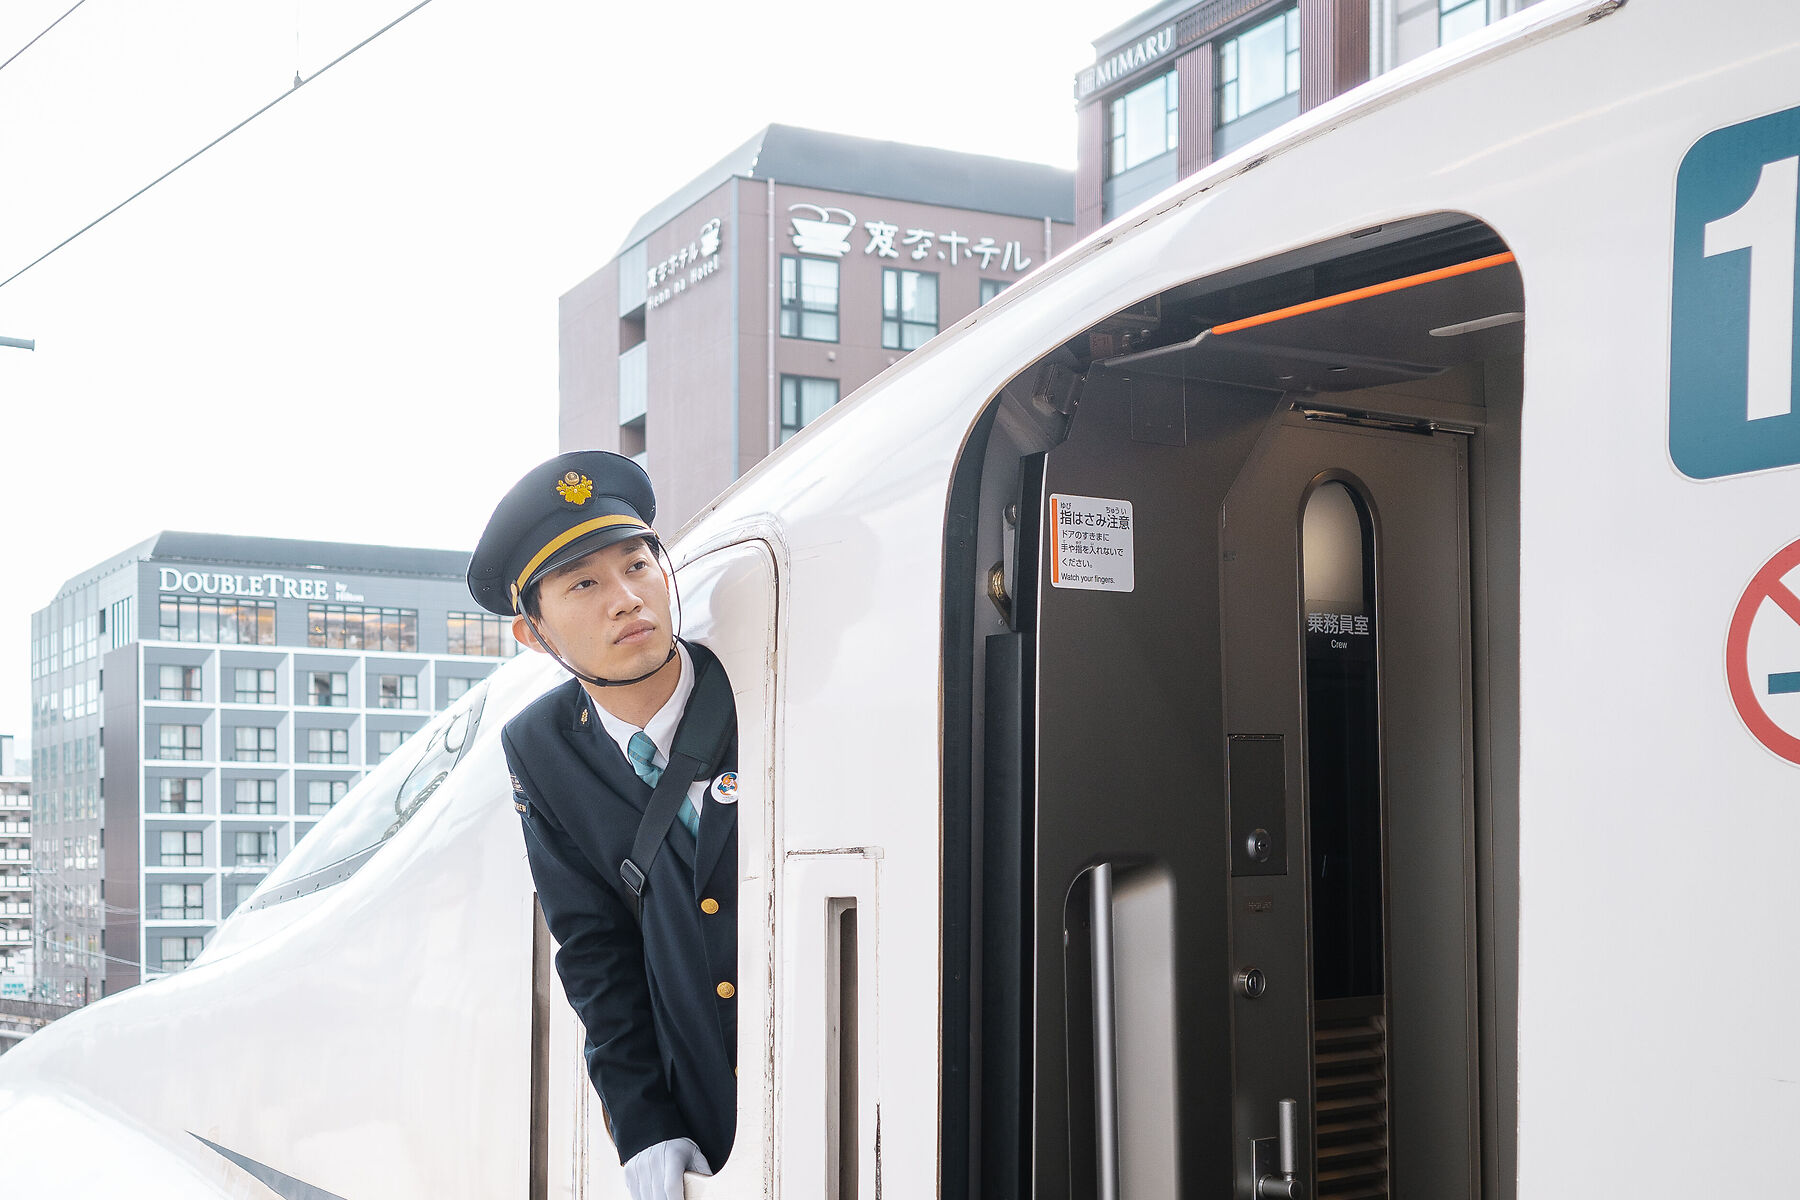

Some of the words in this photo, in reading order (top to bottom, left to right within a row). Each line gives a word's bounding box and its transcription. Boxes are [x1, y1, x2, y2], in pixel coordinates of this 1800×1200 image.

[1096, 27, 1171, 86] MIMARU
[864, 220, 1032, 272] 変なホテル
[690, 254, 719, 284] Hotel
[1703, 155, 1800, 422] 1
[1060, 510, 1130, 530] 指はさみ注意
[1062, 530, 1110, 541] ドアのすきまに
[1061, 543, 1124, 557] 手や指を入れないで
[1062, 558, 1093, 568] ください。
[1061, 573, 1080, 581] Watch
[1080, 575, 1093, 583] your
[1094, 574, 1115, 584] fingers.
[1308, 612, 1370, 635] 乗務員室
[1331, 639, 1348, 649] Crew
